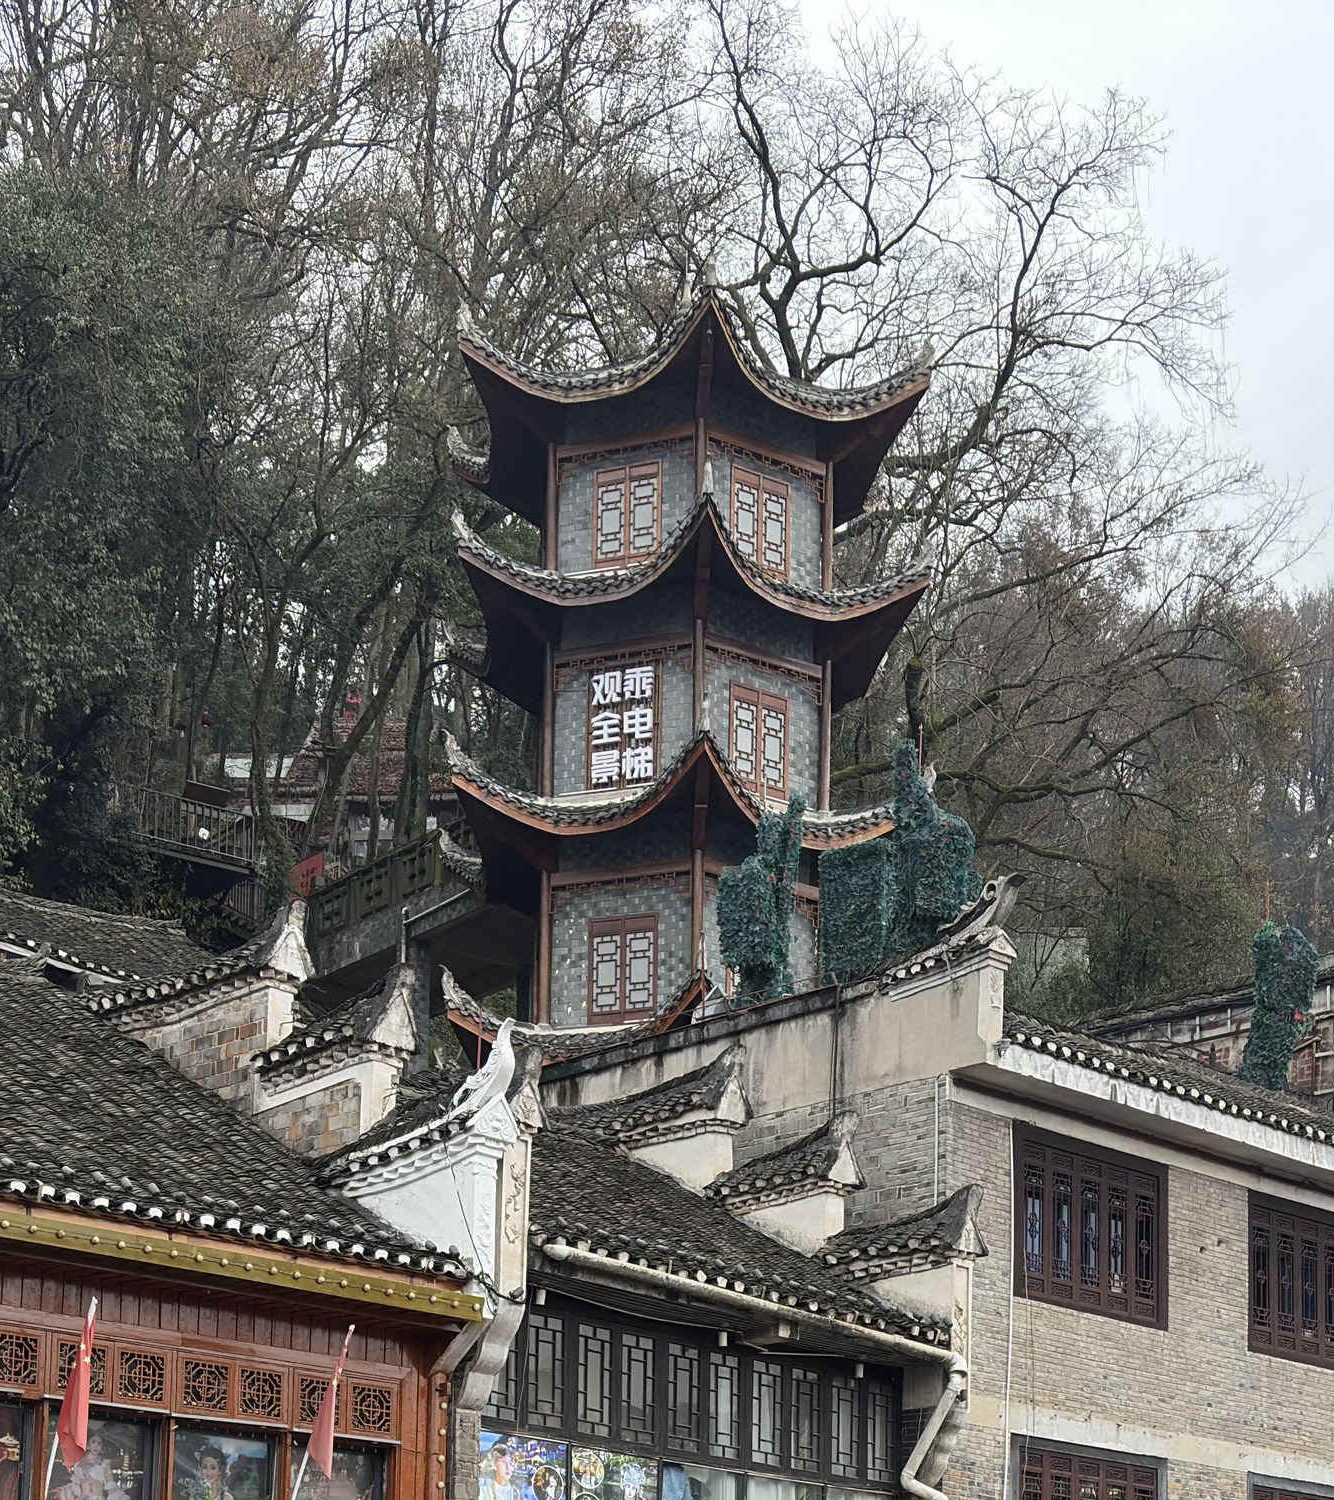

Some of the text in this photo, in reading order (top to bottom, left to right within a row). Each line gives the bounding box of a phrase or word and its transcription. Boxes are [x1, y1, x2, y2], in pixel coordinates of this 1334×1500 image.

[590, 671, 623, 784] 观全景
[621, 665, 655, 780] 乘电梯
